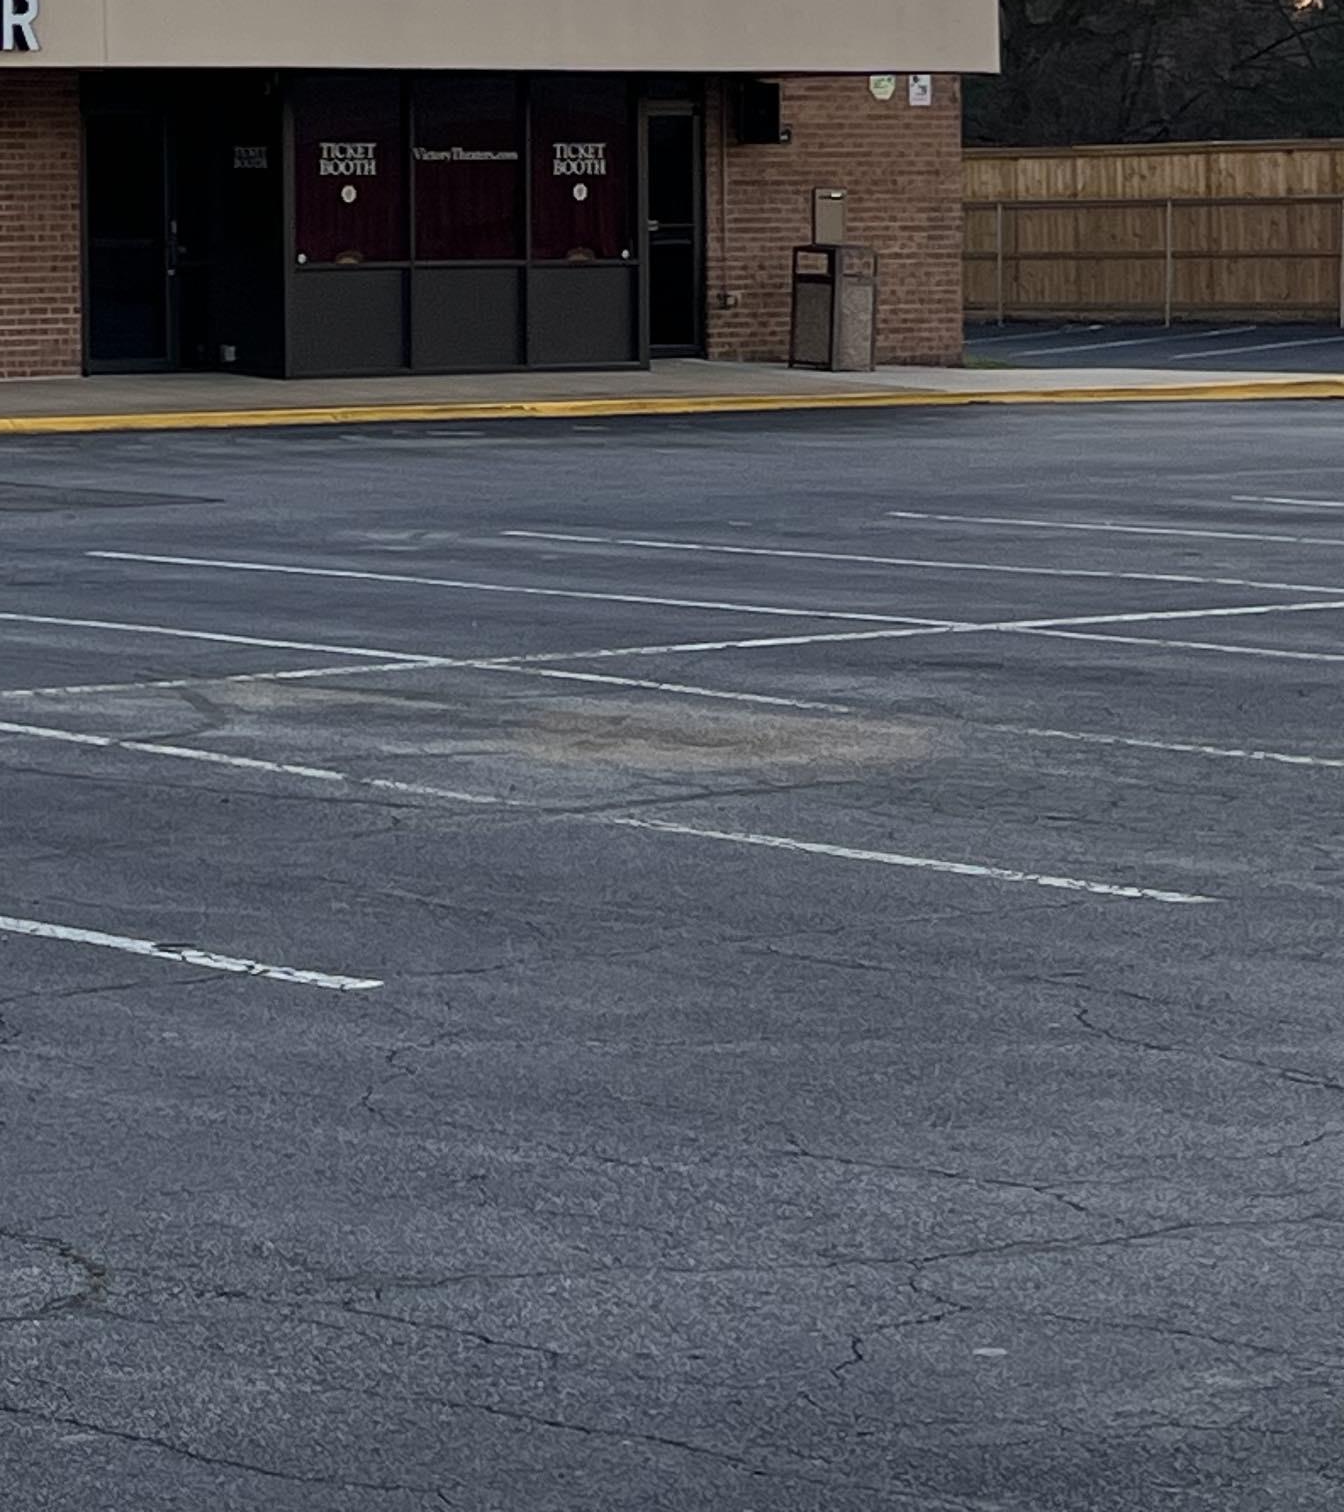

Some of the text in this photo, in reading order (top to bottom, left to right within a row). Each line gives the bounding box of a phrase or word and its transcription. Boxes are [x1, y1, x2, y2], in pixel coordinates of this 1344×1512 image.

[319, 142, 377, 158] TICKET
[552, 142, 607, 158] TICKET
[319, 159, 377, 176] BOOTH
[552, 159, 607, 176] BOOTH
